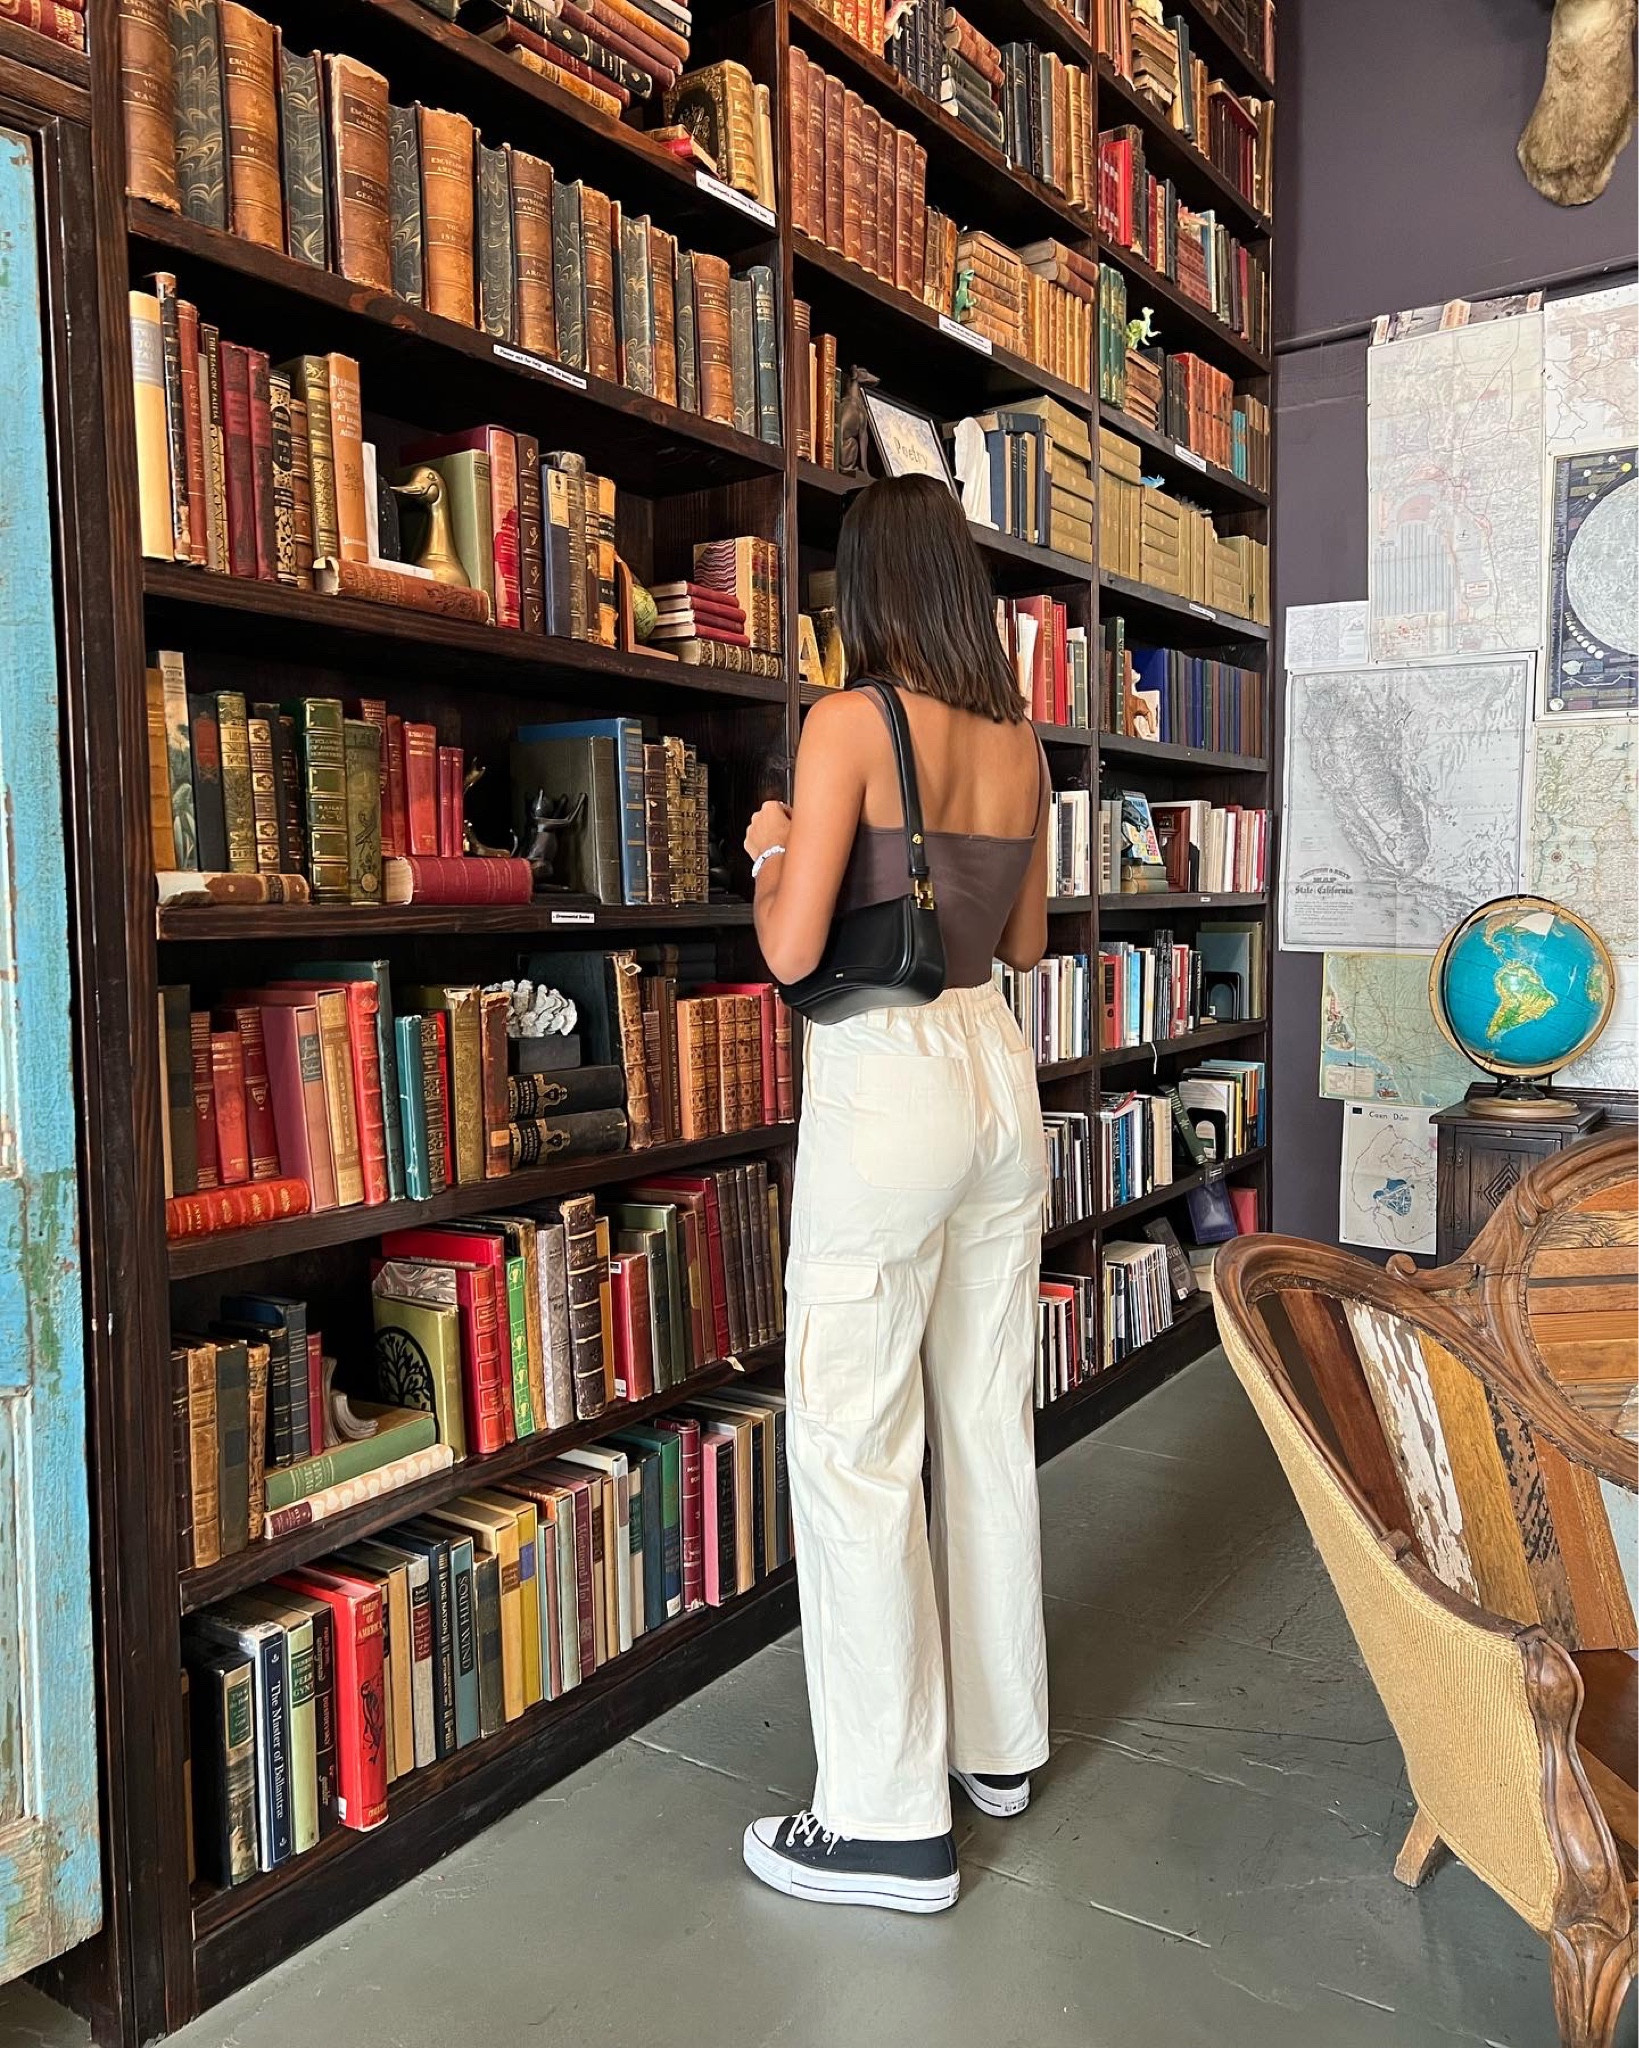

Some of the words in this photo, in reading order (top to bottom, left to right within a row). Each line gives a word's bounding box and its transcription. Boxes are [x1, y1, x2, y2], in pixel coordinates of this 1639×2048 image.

[209, 337, 217, 351] THE
[210, 380, 218, 390] OF
[893, 436, 928, 471] Poetry
[577, 1521, 591, 1578] Westward
[439, 1581, 448, 1600] ONE
[457, 1575, 470, 1625] SOUTH
[578, 1582, 591, 1603] Ho!
[362, 1599, 379, 1615] BIRDS
[366, 1612, 374, 1624] OF
[441, 1601, 451, 1635] NATION
[357, 1619, 383, 1640] AMERICA
[459, 1628, 472, 1670] WIND
[293, 1681, 314, 1698] GYNT
[294, 1671, 313, 1687] PEER
[270, 1680, 282, 1705] The
[271, 1706, 282, 1746] Master
[273, 1749, 283, 1763] of
